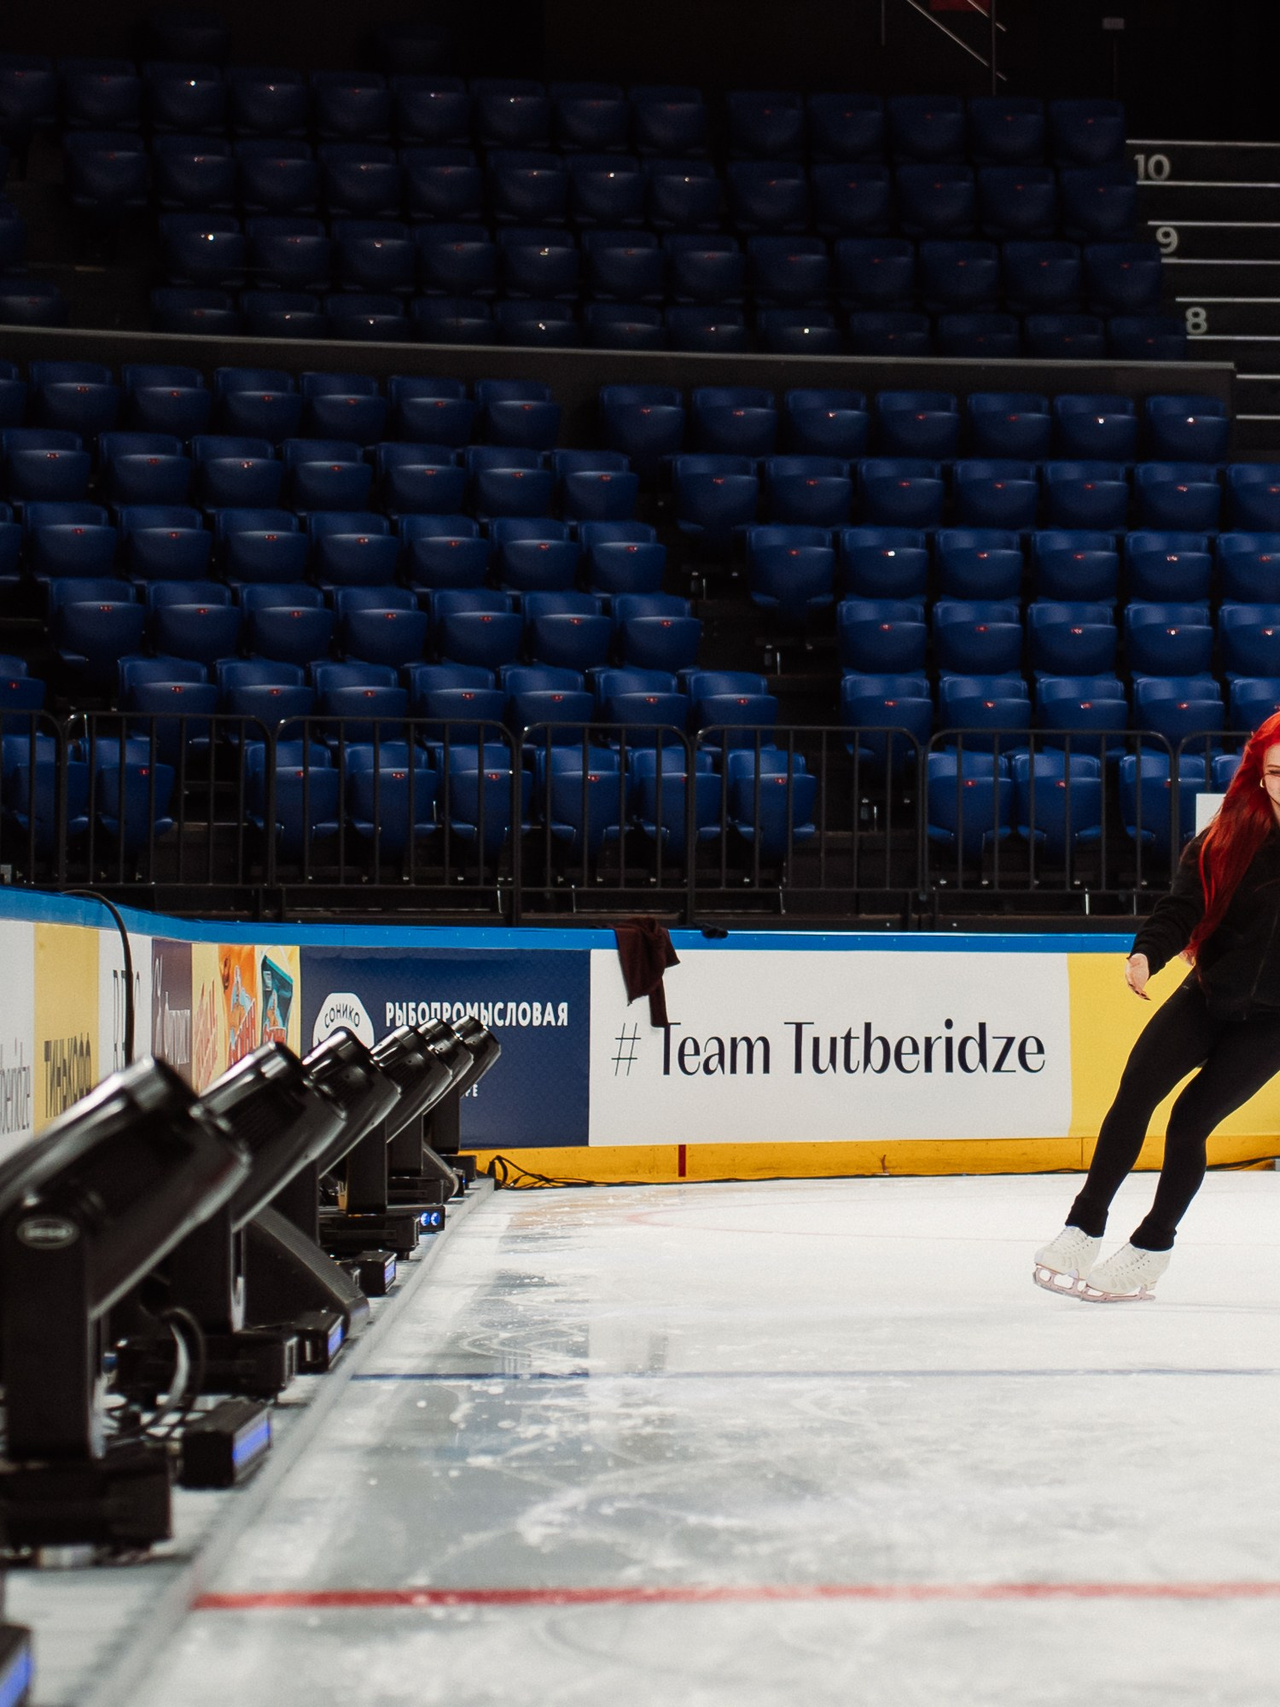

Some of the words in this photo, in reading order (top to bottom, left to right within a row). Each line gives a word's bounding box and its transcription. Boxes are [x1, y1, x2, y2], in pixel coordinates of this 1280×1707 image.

[1134, 154, 1170, 181] 10
[1156, 227, 1178, 254] 9
[1185, 307, 1207, 335] 8
[324, 1003, 361, 1029] СОНИКО
[385, 1002, 568, 1027] РЫБОПРОМЫСЛОВАЯ
[661, 1022, 771, 1076] Team
[784, 1018, 1046, 1075] Tutberidze
